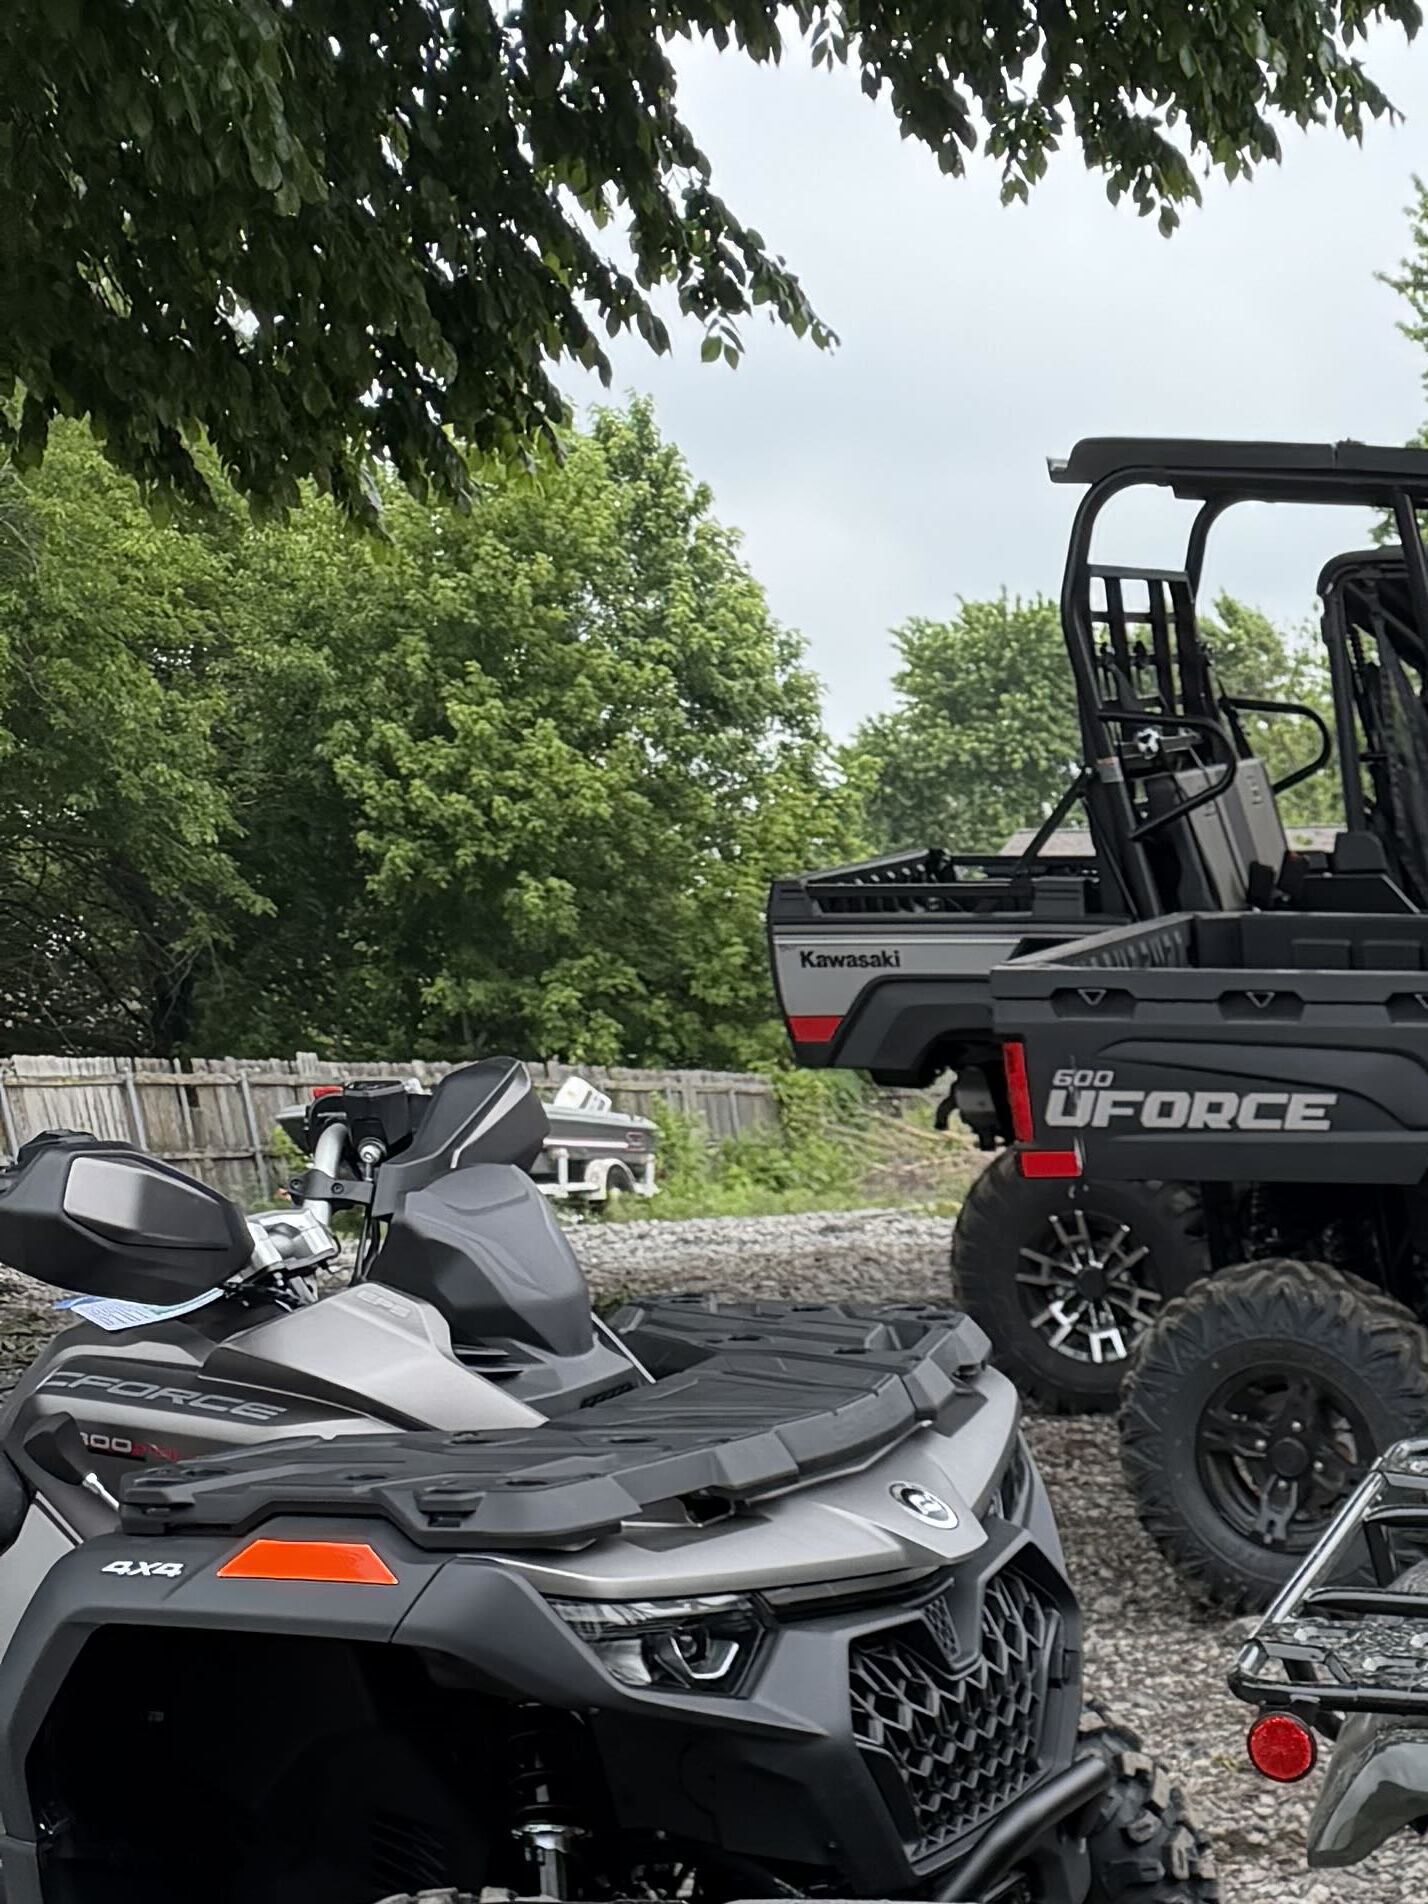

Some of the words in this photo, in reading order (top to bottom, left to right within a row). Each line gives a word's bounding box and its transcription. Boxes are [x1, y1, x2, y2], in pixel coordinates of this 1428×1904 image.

[799, 949, 901, 969] Kawasaki
[1052, 1069, 1115, 1087] 600
[1044, 1089, 1338, 1131] UFORCE
[43, 1370, 289, 1422] CFORCE
[101, 1560, 185, 1578] 4X4
